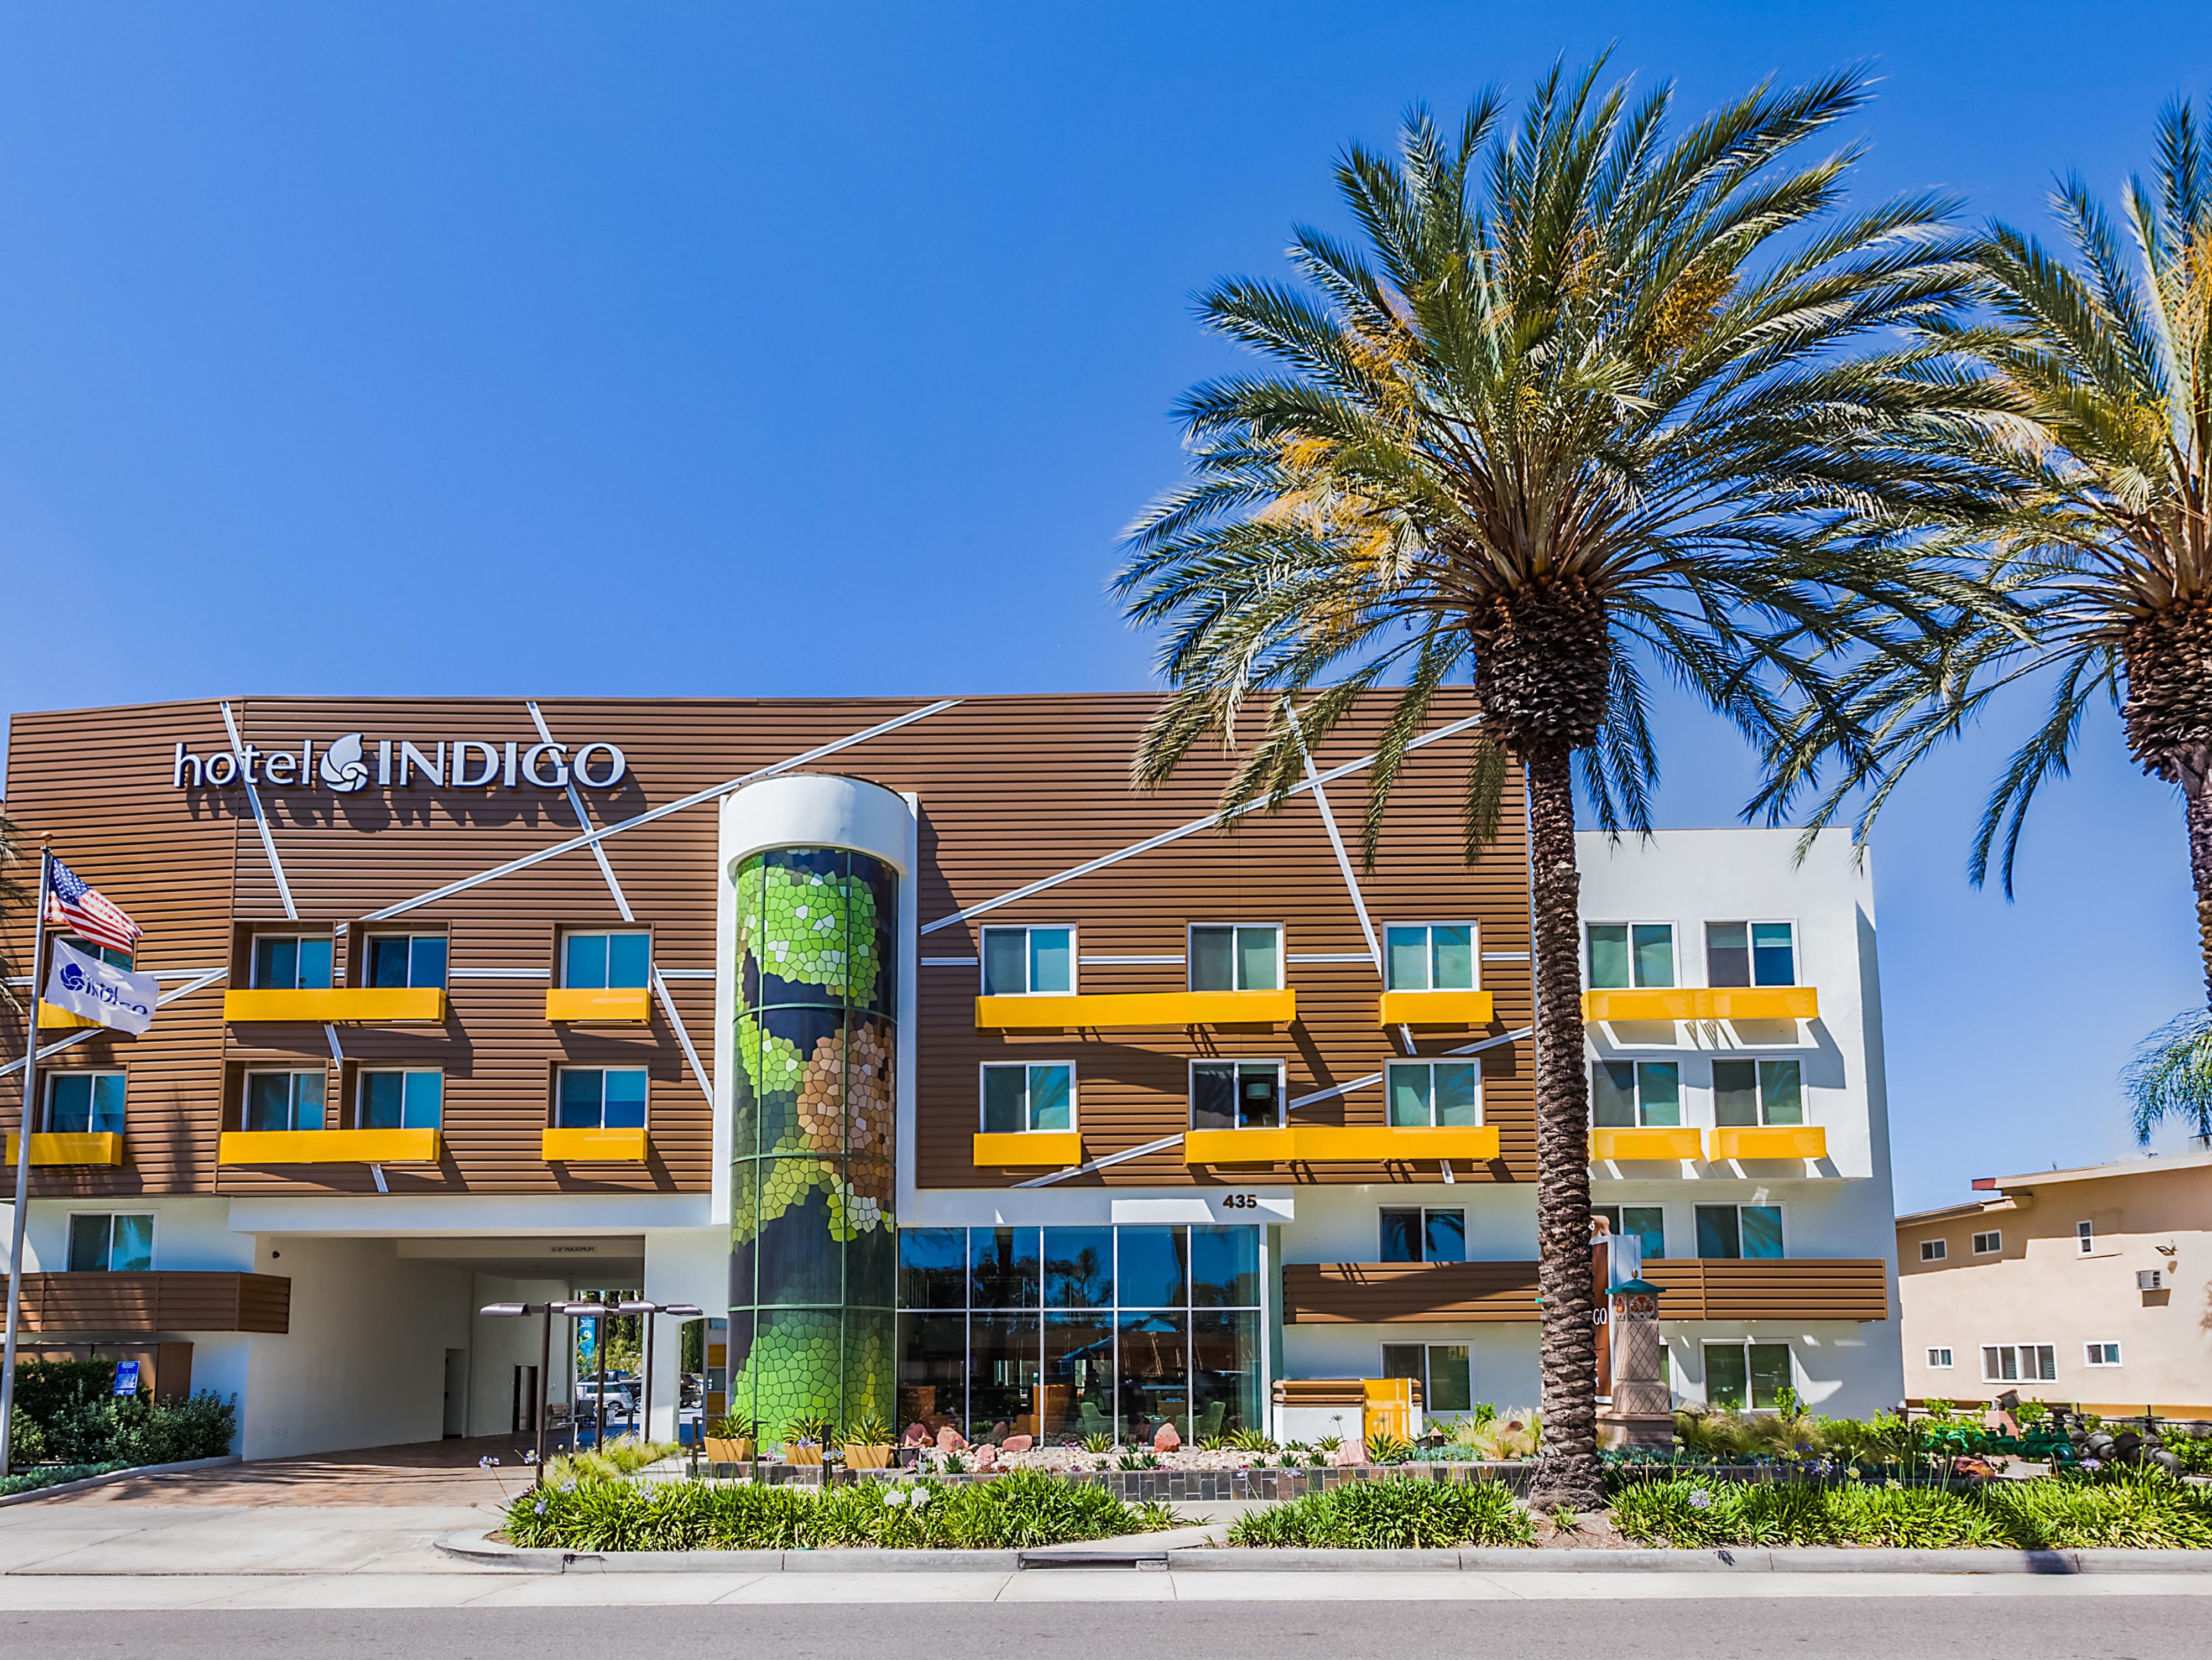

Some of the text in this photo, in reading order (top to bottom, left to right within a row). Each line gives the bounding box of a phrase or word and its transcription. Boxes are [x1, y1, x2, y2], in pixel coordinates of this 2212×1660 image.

[173, 740, 627, 788] hotel INDIGO
[1223, 1194, 1257, 1209] 435
